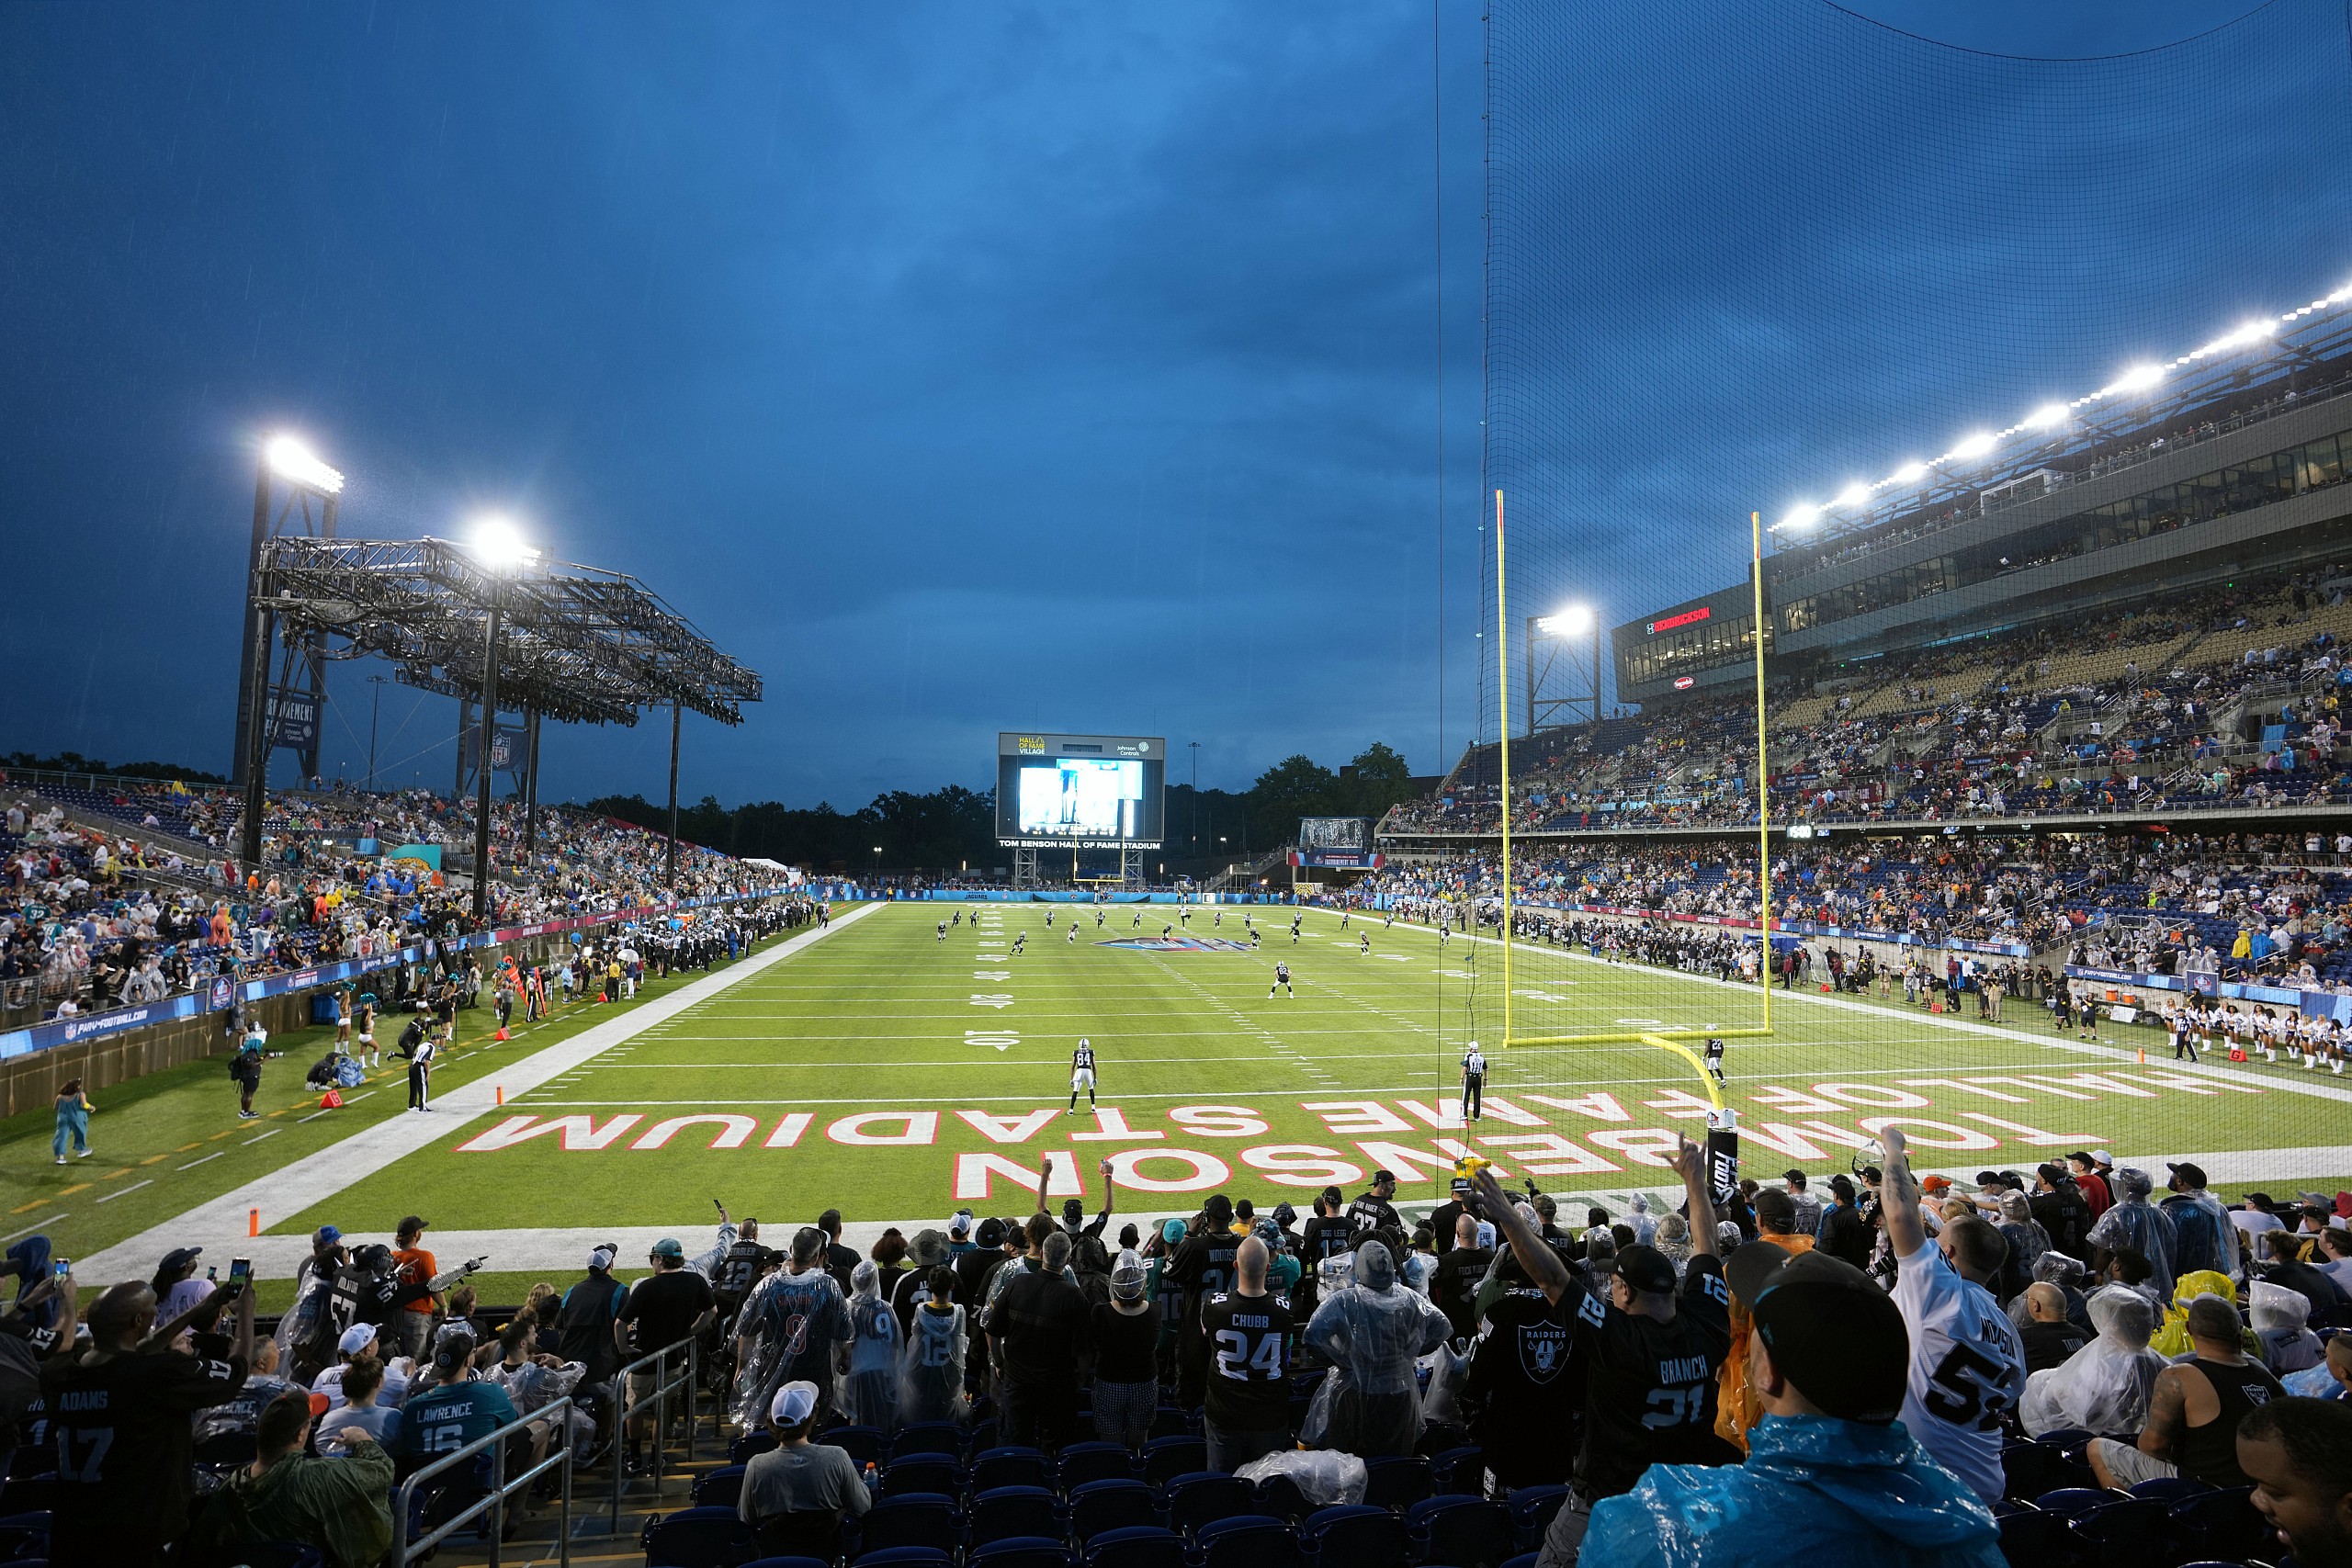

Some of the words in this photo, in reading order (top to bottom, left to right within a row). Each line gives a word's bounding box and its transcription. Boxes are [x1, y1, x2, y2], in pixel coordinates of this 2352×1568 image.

[1654, 607, 1711, 632] HENDRICKSON
[1021, 840, 1057, 848] BENSON
[1082, 840, 1095, 849] OF
[1122, 841, 1160, 850] STADIUM
[1932, 1003, 1940, 1012] 10
[964, 1030, 1021, 1046] 10
[1712, 1038, 1722, 1050] 22
[1077, 1053, 1091, 1066] 84
[2231, 1050, 2240, 1059] G
[331, 1092, 341, 1104] G
[1748, 1081, 1933, 1114] OF
[1894, 1069, 2269, 1103] HALL
[1299, 1089, 1744, 1134] FAME
[453, 1104, 1271, 1152] STADIUM
[952, 1127, 1745, 1201] BENSON
[728, 1247, 756, 1258] STABLER
[721, 1261, 753, 1292] 12
[1702, 1272, 1729, 1306] 21
[786, 1313, 807, 1356] 9
[876, 1313, 893, 1345] 9
[1232, 1314, 1269, 1329] CHUBB
[31, 1326, 56, 1351] 13
[922, 1334, 952, 1366] 12
[1216, 1329, 1283, 1382] 24
[209, 1359, 232, 1381] 17
[1659, 1355, 1708, 1386] BRANCH
[59, 1390, 108, 1412] ADAMS
[416, 1402, 473, 1424] LAWRENCE
[422, 1424, 463, 1452] 16
[56, 1425, 115, 1483] 17
